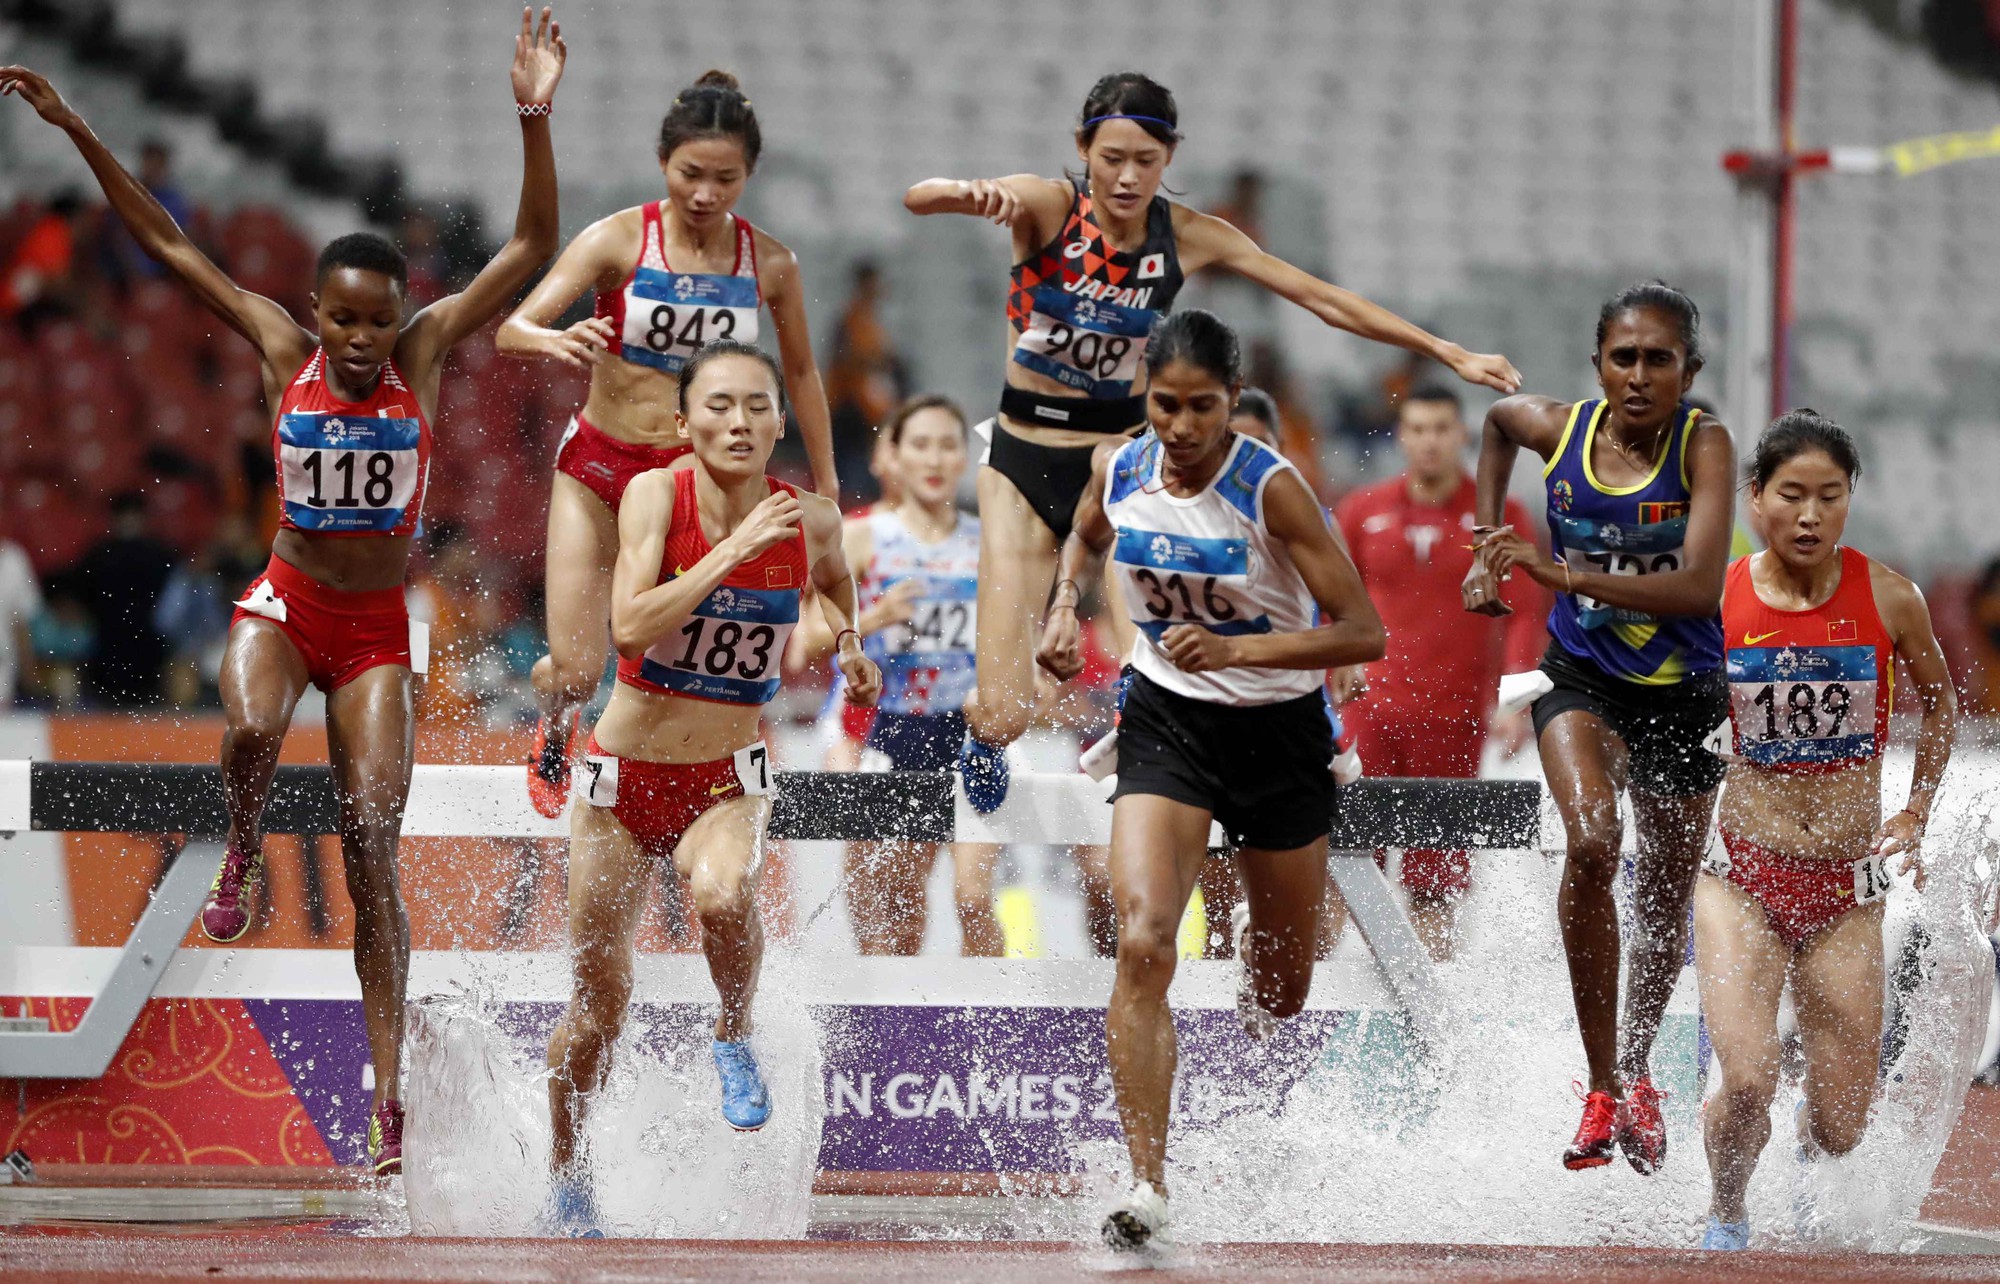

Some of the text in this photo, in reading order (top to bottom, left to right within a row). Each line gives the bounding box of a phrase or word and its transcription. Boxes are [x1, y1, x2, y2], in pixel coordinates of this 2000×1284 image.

[1063, 274, 1153, 310] JAPAN
[1044, 323, 1132, 379] 908
[303, 451, 394, 507] 118
[1136, 568, 1237, 621] 316
[672, 618, 775, 680] 183
[704, 686, 741, 697] PERTAMINA
[1754, 683, 1851, 742] 189
[586, 761, 602, 799] 7
[750, 747, 767, 789] 7
[885, 1073, 1082, 1120] GAMES
